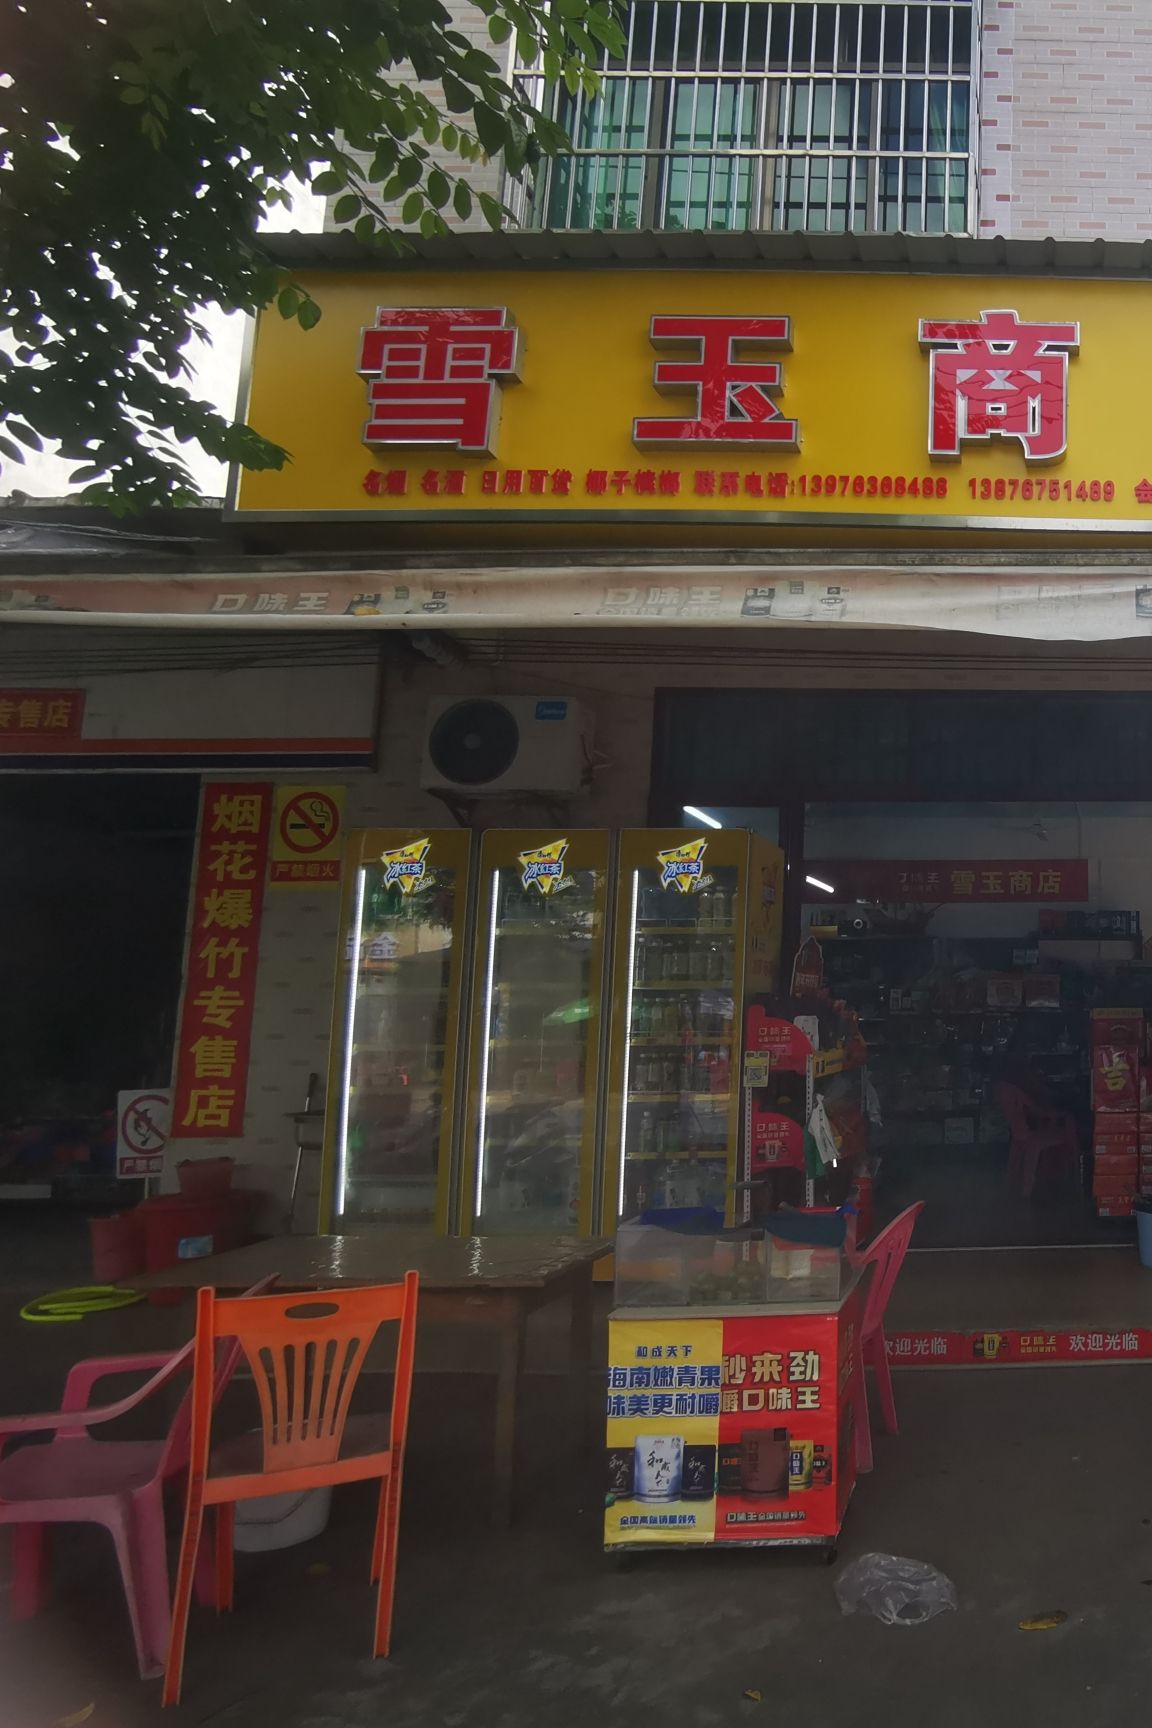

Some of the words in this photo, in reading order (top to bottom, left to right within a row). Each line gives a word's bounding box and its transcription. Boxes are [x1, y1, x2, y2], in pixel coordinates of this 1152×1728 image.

[210, 591, 330, 613] 口味王
[950, 868, 1062, 896] 雪玉商店
[181, 794, 263, 1129] 烟花爆竹专售店
[636, 1345, 694, 1358] 和成天下
[1068, 1332, 1139, 1352] 欢迎光临
[608, 1365, 721, 1389] 海南嫩青果
[607, 1393, 720, 1417] 味美更耐嚼
